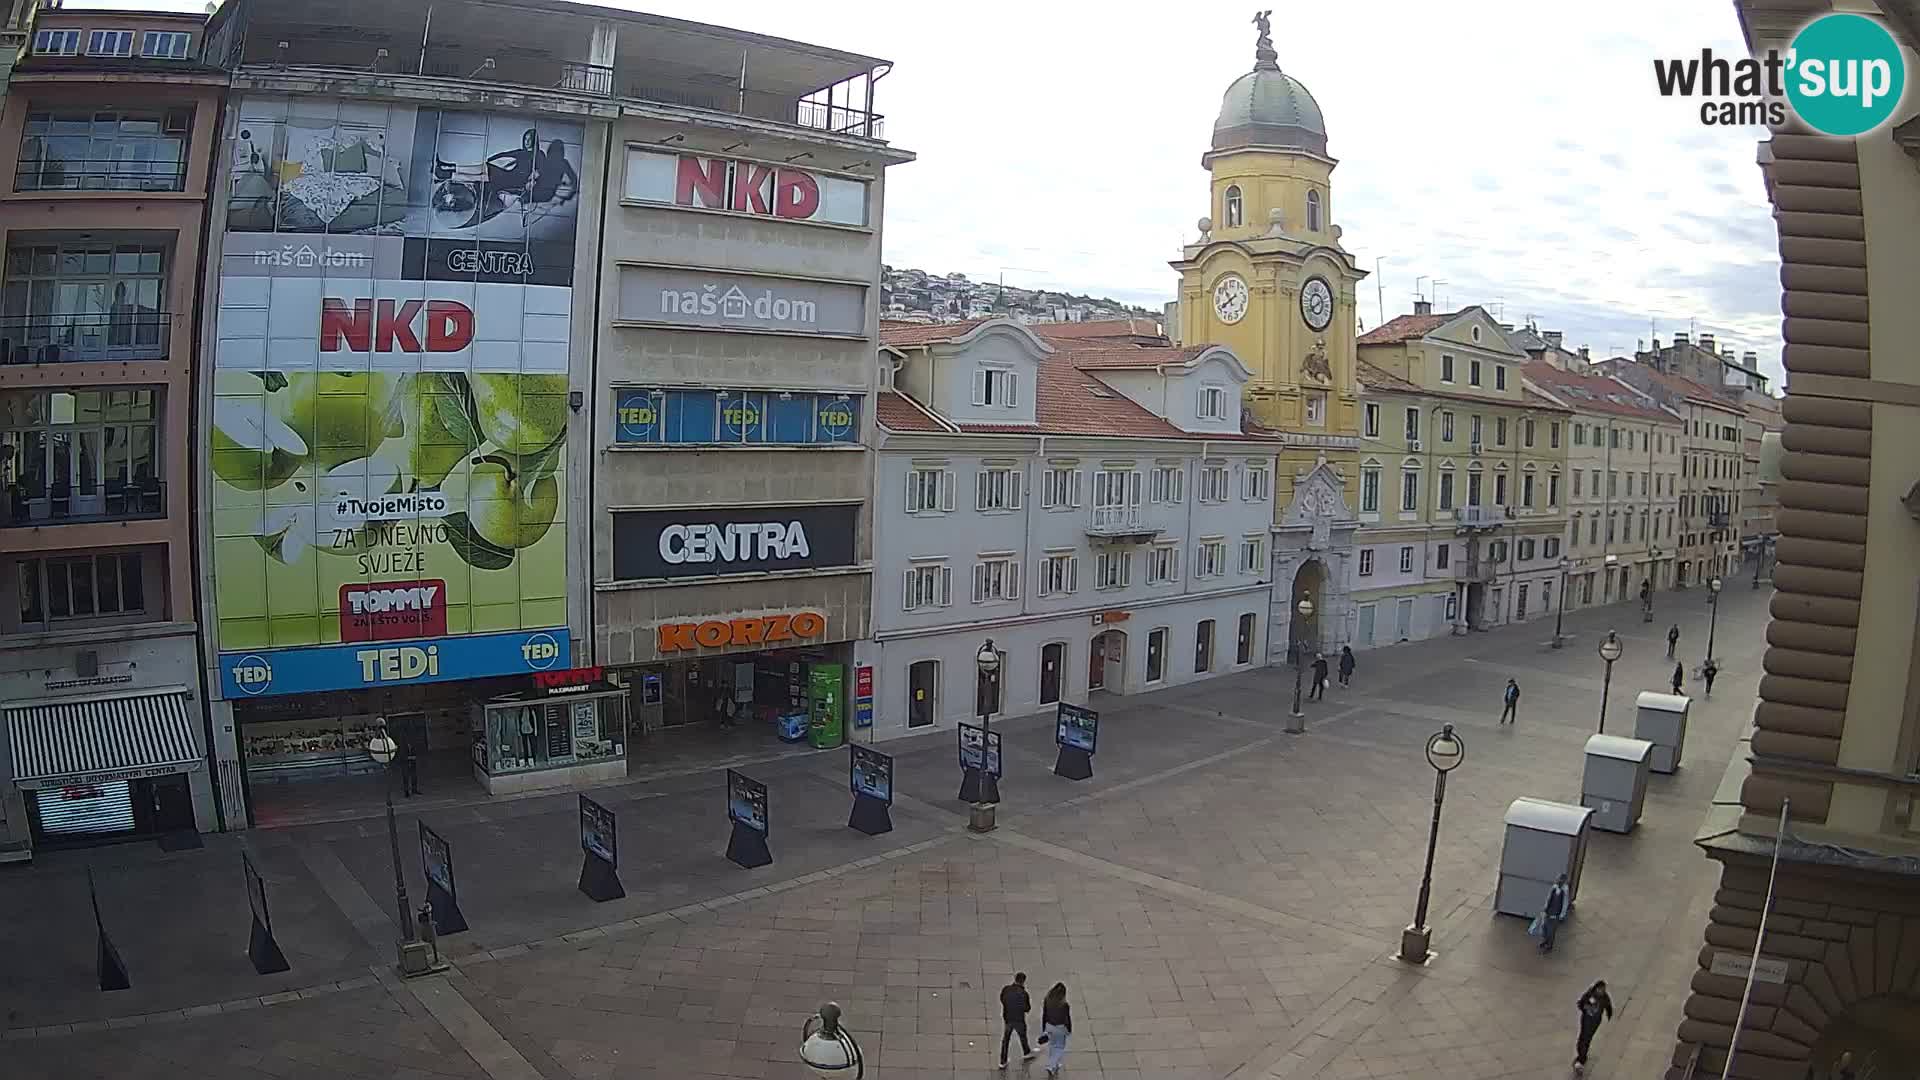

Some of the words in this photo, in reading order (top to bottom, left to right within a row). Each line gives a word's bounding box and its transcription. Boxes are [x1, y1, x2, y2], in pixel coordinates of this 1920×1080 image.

[676, 158, 820, 219] NKD
[254, 246, 293, 266] naš
[319, 247, 364, 268] dom
[447, 249, 534, 275] CENTRA
[660, 284, 717, 315] naš
[753, 289, 816, 322] dom
[319, 297, 475, 353] NKD
[618, 407, 657, 425] TEDi
[723, 408, 760, 425] TEDi
[819, 410, 853, 427] TEDi
[337, 496, 445, 516] #TvojeMisto
[332, 529, 356, 549] ZA
[366, 523, 449, 548] DNEVNO
[658, 520, 810, 564] CENTRA
[358, 547, 425, 575] SVJEŽE
[347, 586, 438, 614] TOMMY
[657, 612, 826, 653] KORZO
[356, 645, 439, 682] TEDi
[521, 642, 559, 661] TEDi
[232, 663, 273, 685] TEDi
